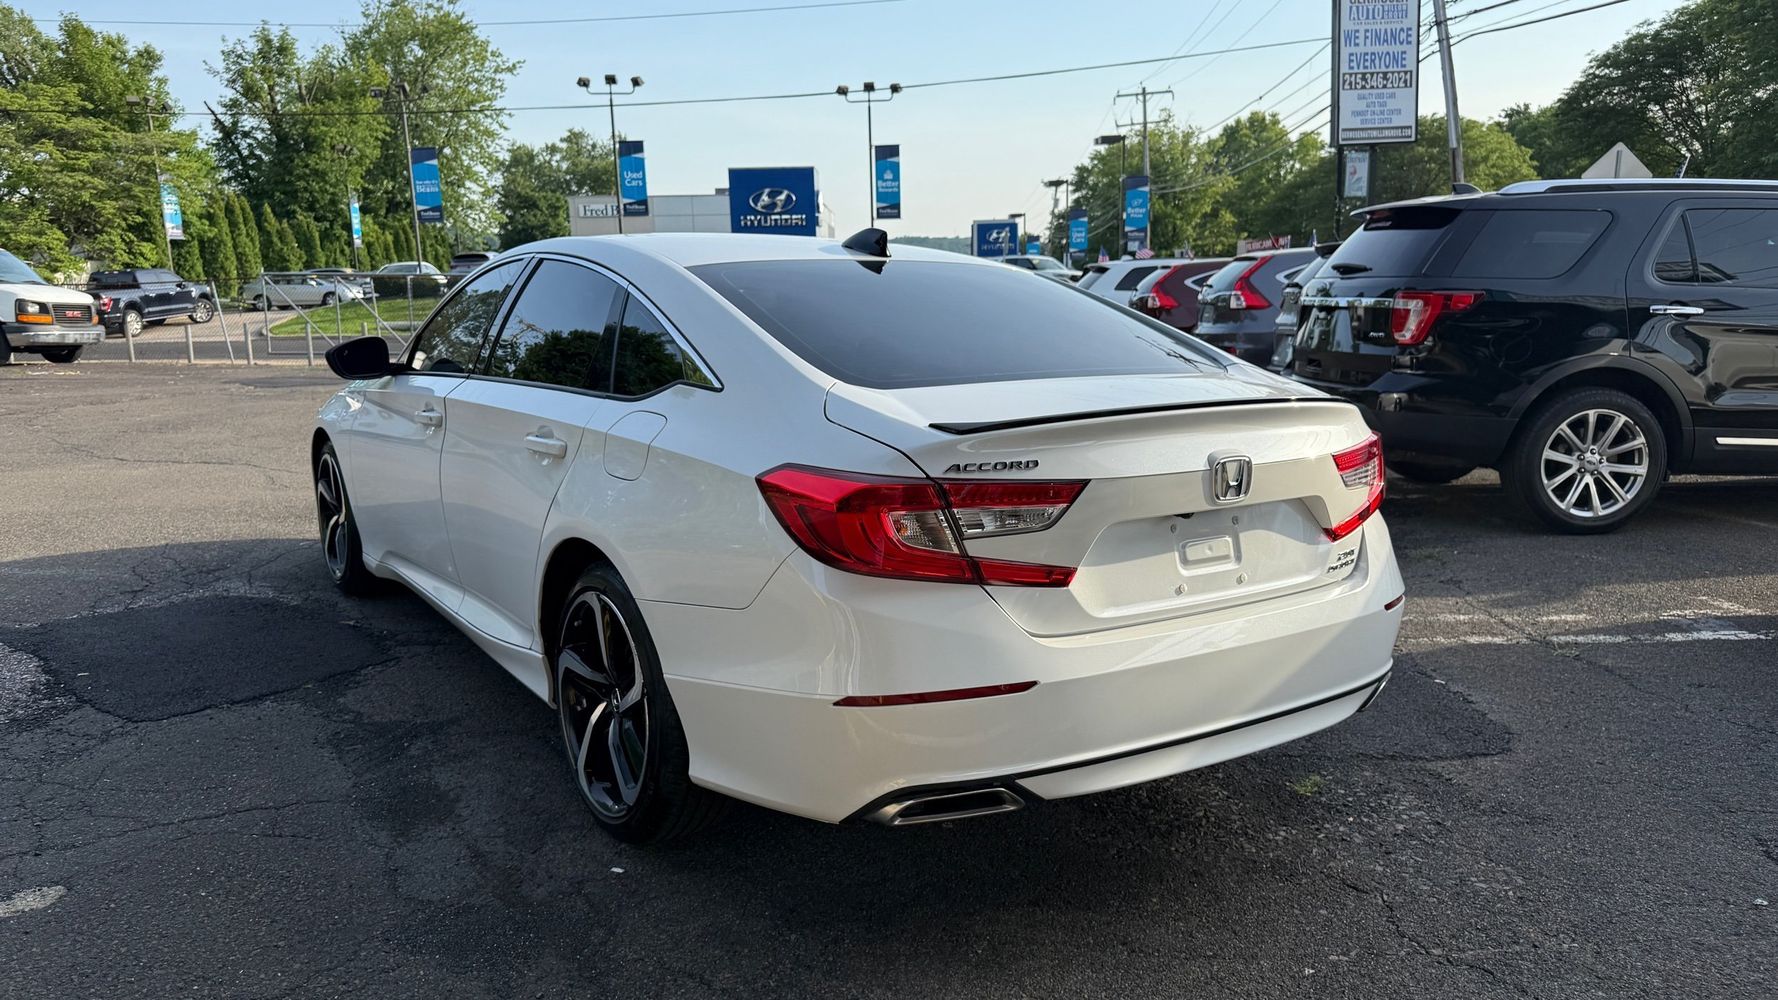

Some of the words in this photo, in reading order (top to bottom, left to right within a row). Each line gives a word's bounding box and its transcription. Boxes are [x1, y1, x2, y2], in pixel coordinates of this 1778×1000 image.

[1350, 5, 1383, 20] AUTO
[1344, 29, 1360, 47] WE
[1364, 27, 1412, 46] FINANCE
[1348, 51, 1407, 70] EVERYONE
[1343, 72, 1411, 89] 215-346-2021
[624, 170, 642, 179] Used
[625, 178, 643, 187] Cars
[583, 204, 608, 216] Fred
[740, 214, 806, 227] HYUNDAI
[944, 460, 1040, 474] ACCORD
